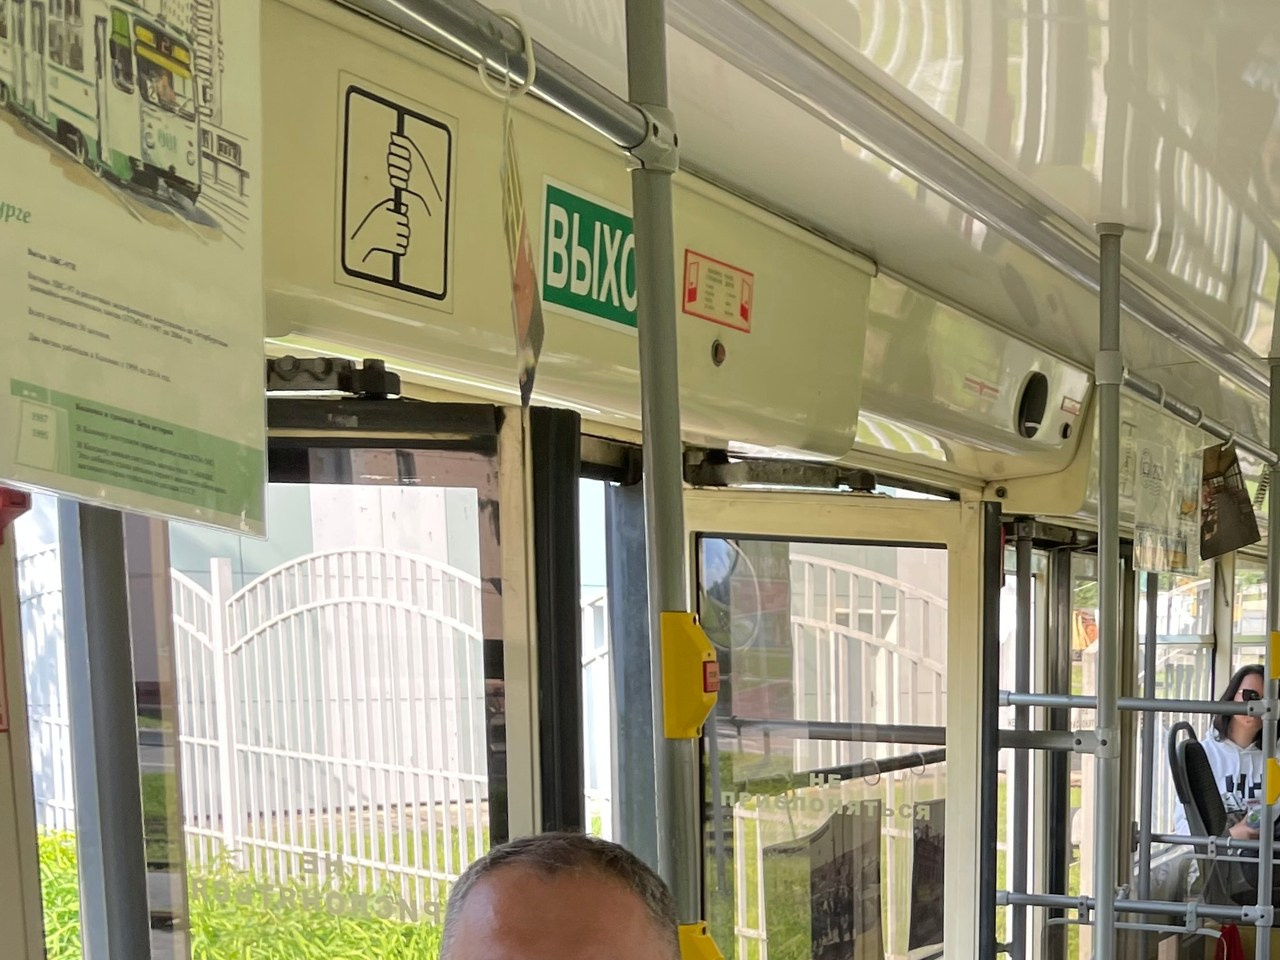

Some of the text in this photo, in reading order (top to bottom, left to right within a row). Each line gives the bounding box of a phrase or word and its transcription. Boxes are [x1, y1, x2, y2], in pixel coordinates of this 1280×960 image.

[546, 202, 638, 312] ВЫХО
[809, 772, 842, 789] НЕ
[721, 791, 931, 821] ПРИСЛОНЯТЬСЯ
